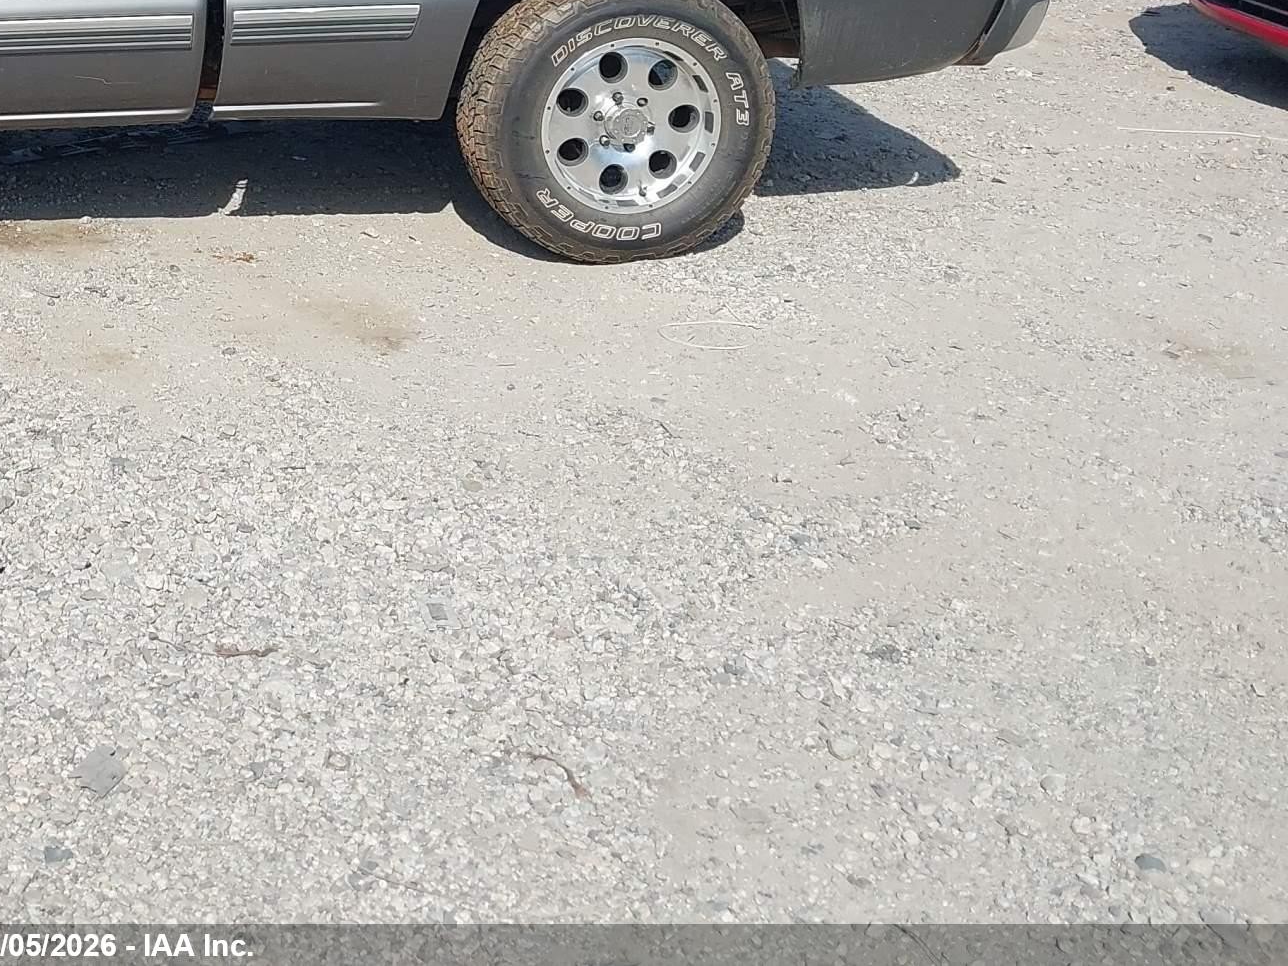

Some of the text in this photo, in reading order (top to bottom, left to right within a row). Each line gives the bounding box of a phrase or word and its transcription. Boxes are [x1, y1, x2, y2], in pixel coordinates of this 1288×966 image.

[551, 14, 750, 126] DISCOVERER AT3
[536, 188, 662, 241] COOPER
